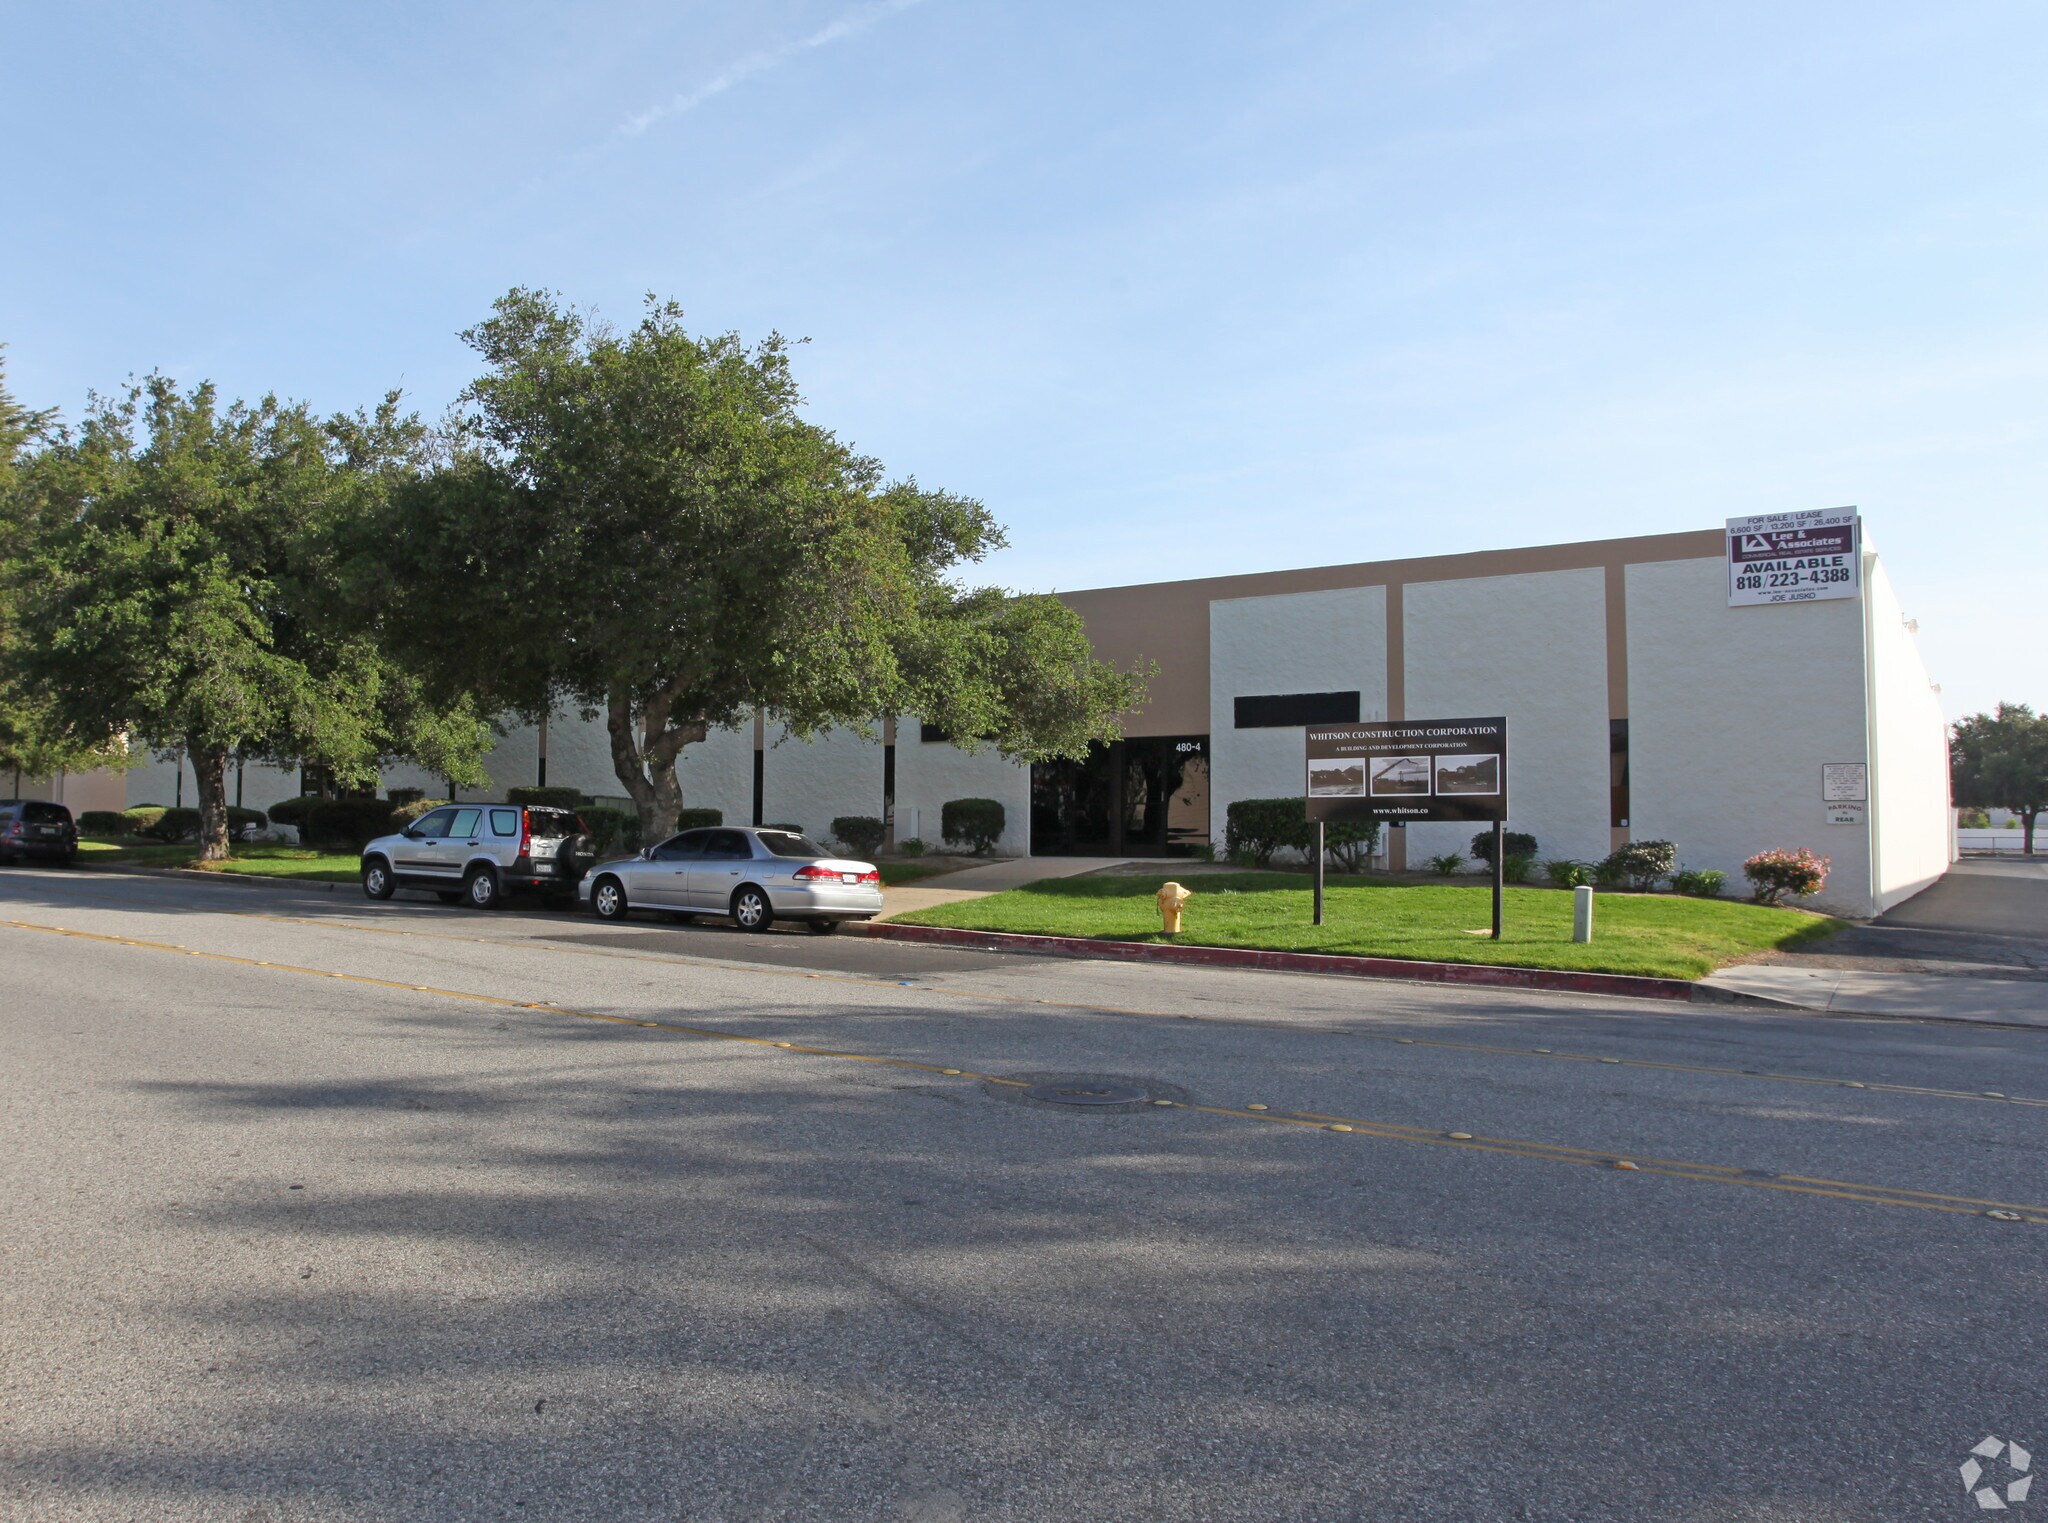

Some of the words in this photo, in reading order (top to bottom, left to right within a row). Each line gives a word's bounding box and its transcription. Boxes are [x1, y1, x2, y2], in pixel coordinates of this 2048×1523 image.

[1747, 517, 1765, 525] FOR
[1766, 514, 1788, 523] SALE
[1795, 510, 1823, 520] LEASE
[1753, 524, 1764, 532] SF
[1796, 520, 1807, 528] SF
[1842, 515, 1853, 524] SF
[1771, 532, 1794, 542] Lee
[1797, 530, 1807, 539] &
[1776, 537, 1842, 550] Associates
[1742, 556, 1844, 575] AVAILABLE
[1736, 567, 1850, 590] 818/223-4388
[1788, 592, 1816, 601] JUSKO
[1309, 732, 1351, 741] WHITSON
[1352, 729, 1424, 739] CONSTRUCTION
[1426, 726, 1498, 737] CORPORATION
[1175, 742, 1201, 752] 480-4
[1380, 743, 1424, 751] DEVELOPMENT
[1424, 741, 1468, 749] CORPORATION
[1372, 806, 1429, 814] www.whitson.co
[1828, 804, 1862, 812] PARKING
